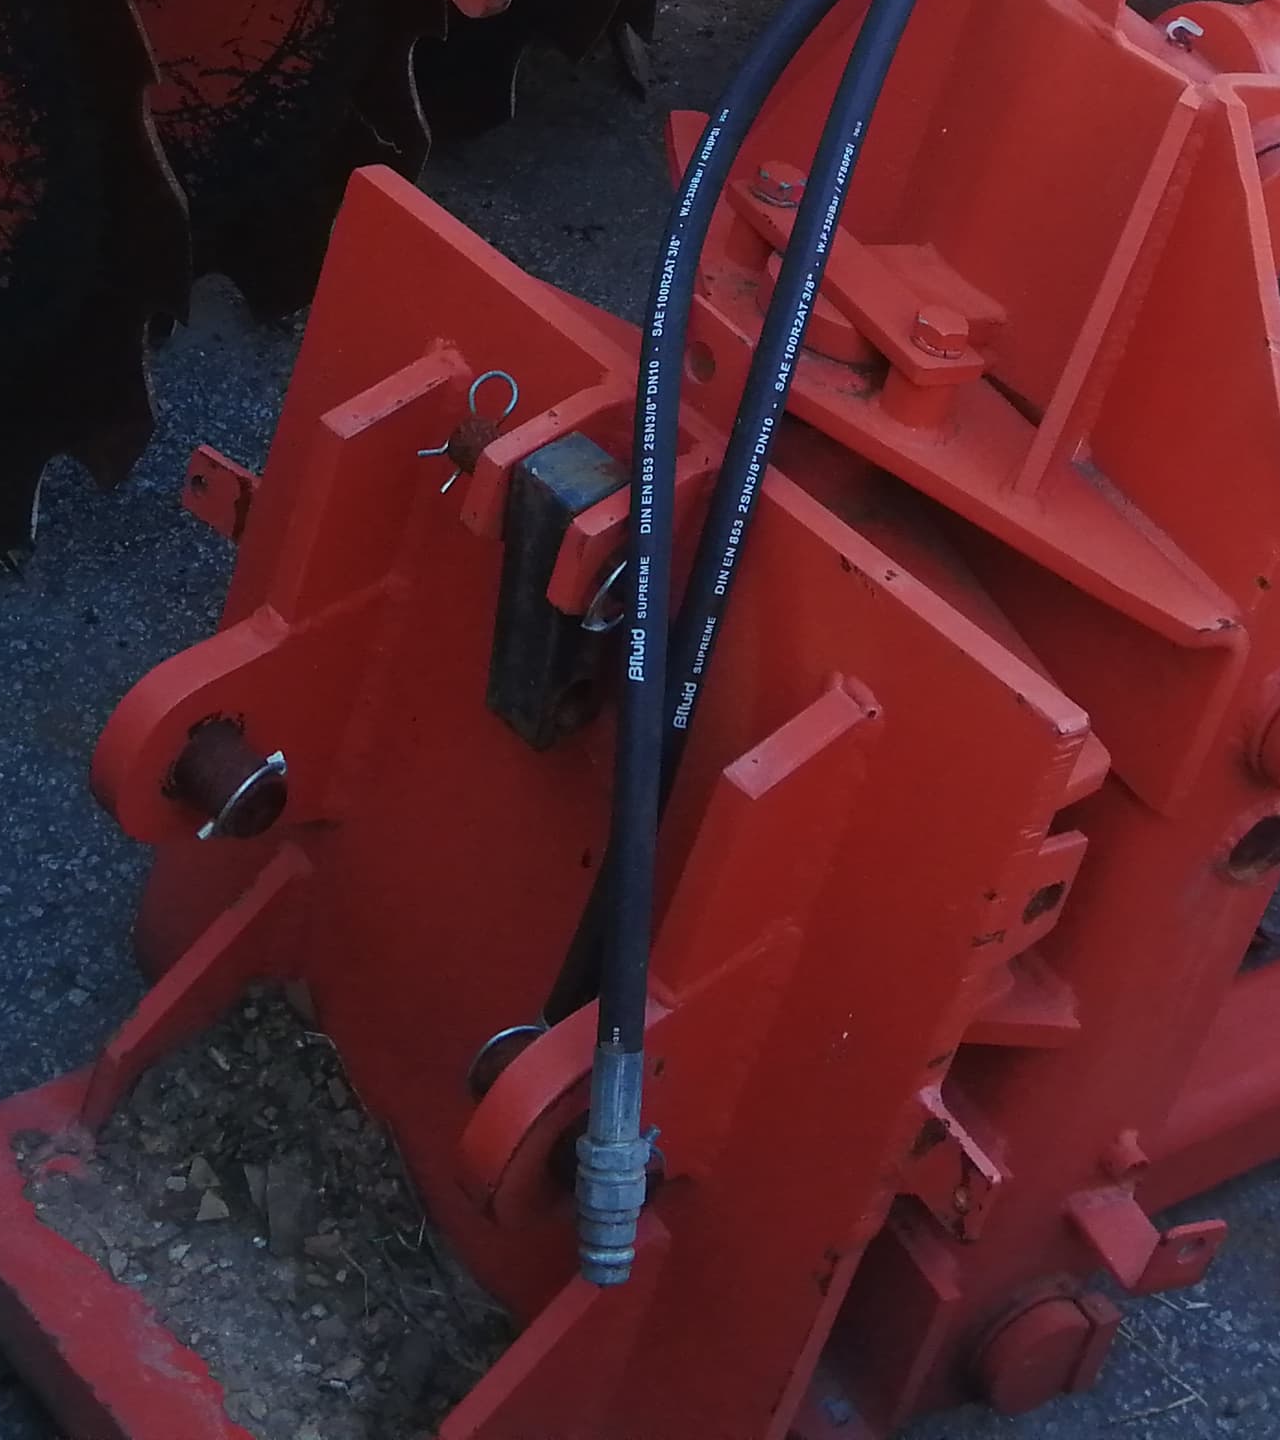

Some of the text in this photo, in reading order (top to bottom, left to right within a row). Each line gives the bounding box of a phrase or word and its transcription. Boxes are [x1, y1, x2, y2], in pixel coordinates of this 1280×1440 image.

[652, 311, 665, 337] SAE
[784, 301, 809, 359] 100R2AT
[775, 363, 791, 392] SAE
[642, 457, 654, 482] 853
[641, 485, 654, 505] EN
[640, 507, 652, 534] DIN
[729, 519, 744, 545] 853
[722, 547, 737, 568] EN
[637, 556, 650, 619] SUPREME
[714, 570, 730, 595] DIN
[693, 616, 717, 674] SUPREME
